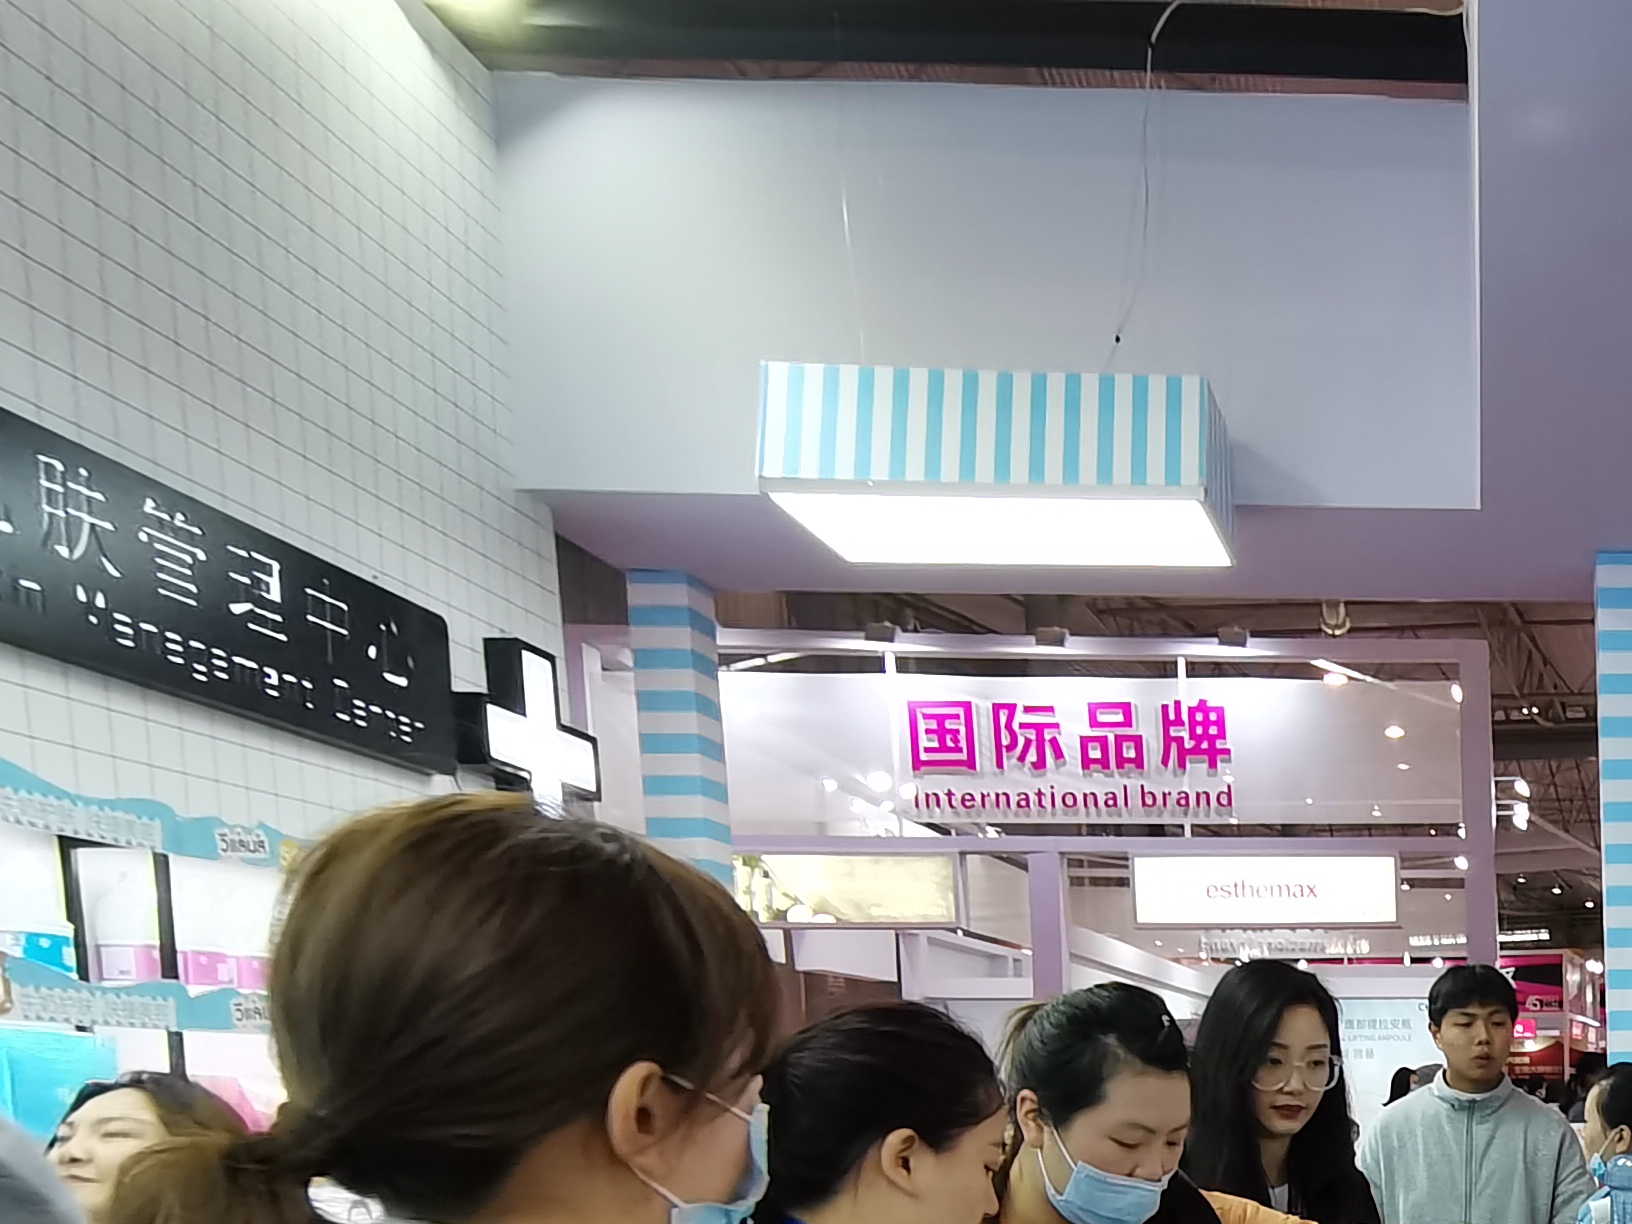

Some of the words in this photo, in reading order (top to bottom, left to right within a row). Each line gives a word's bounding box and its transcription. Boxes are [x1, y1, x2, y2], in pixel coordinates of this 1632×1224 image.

[0, 453, 417, 688] 肤管理中心
[907, 698, 1232, 772] 国际品牌
[1139, 783, 1234, 809] brand
[1205, 878, 1319, 899] esthemax
